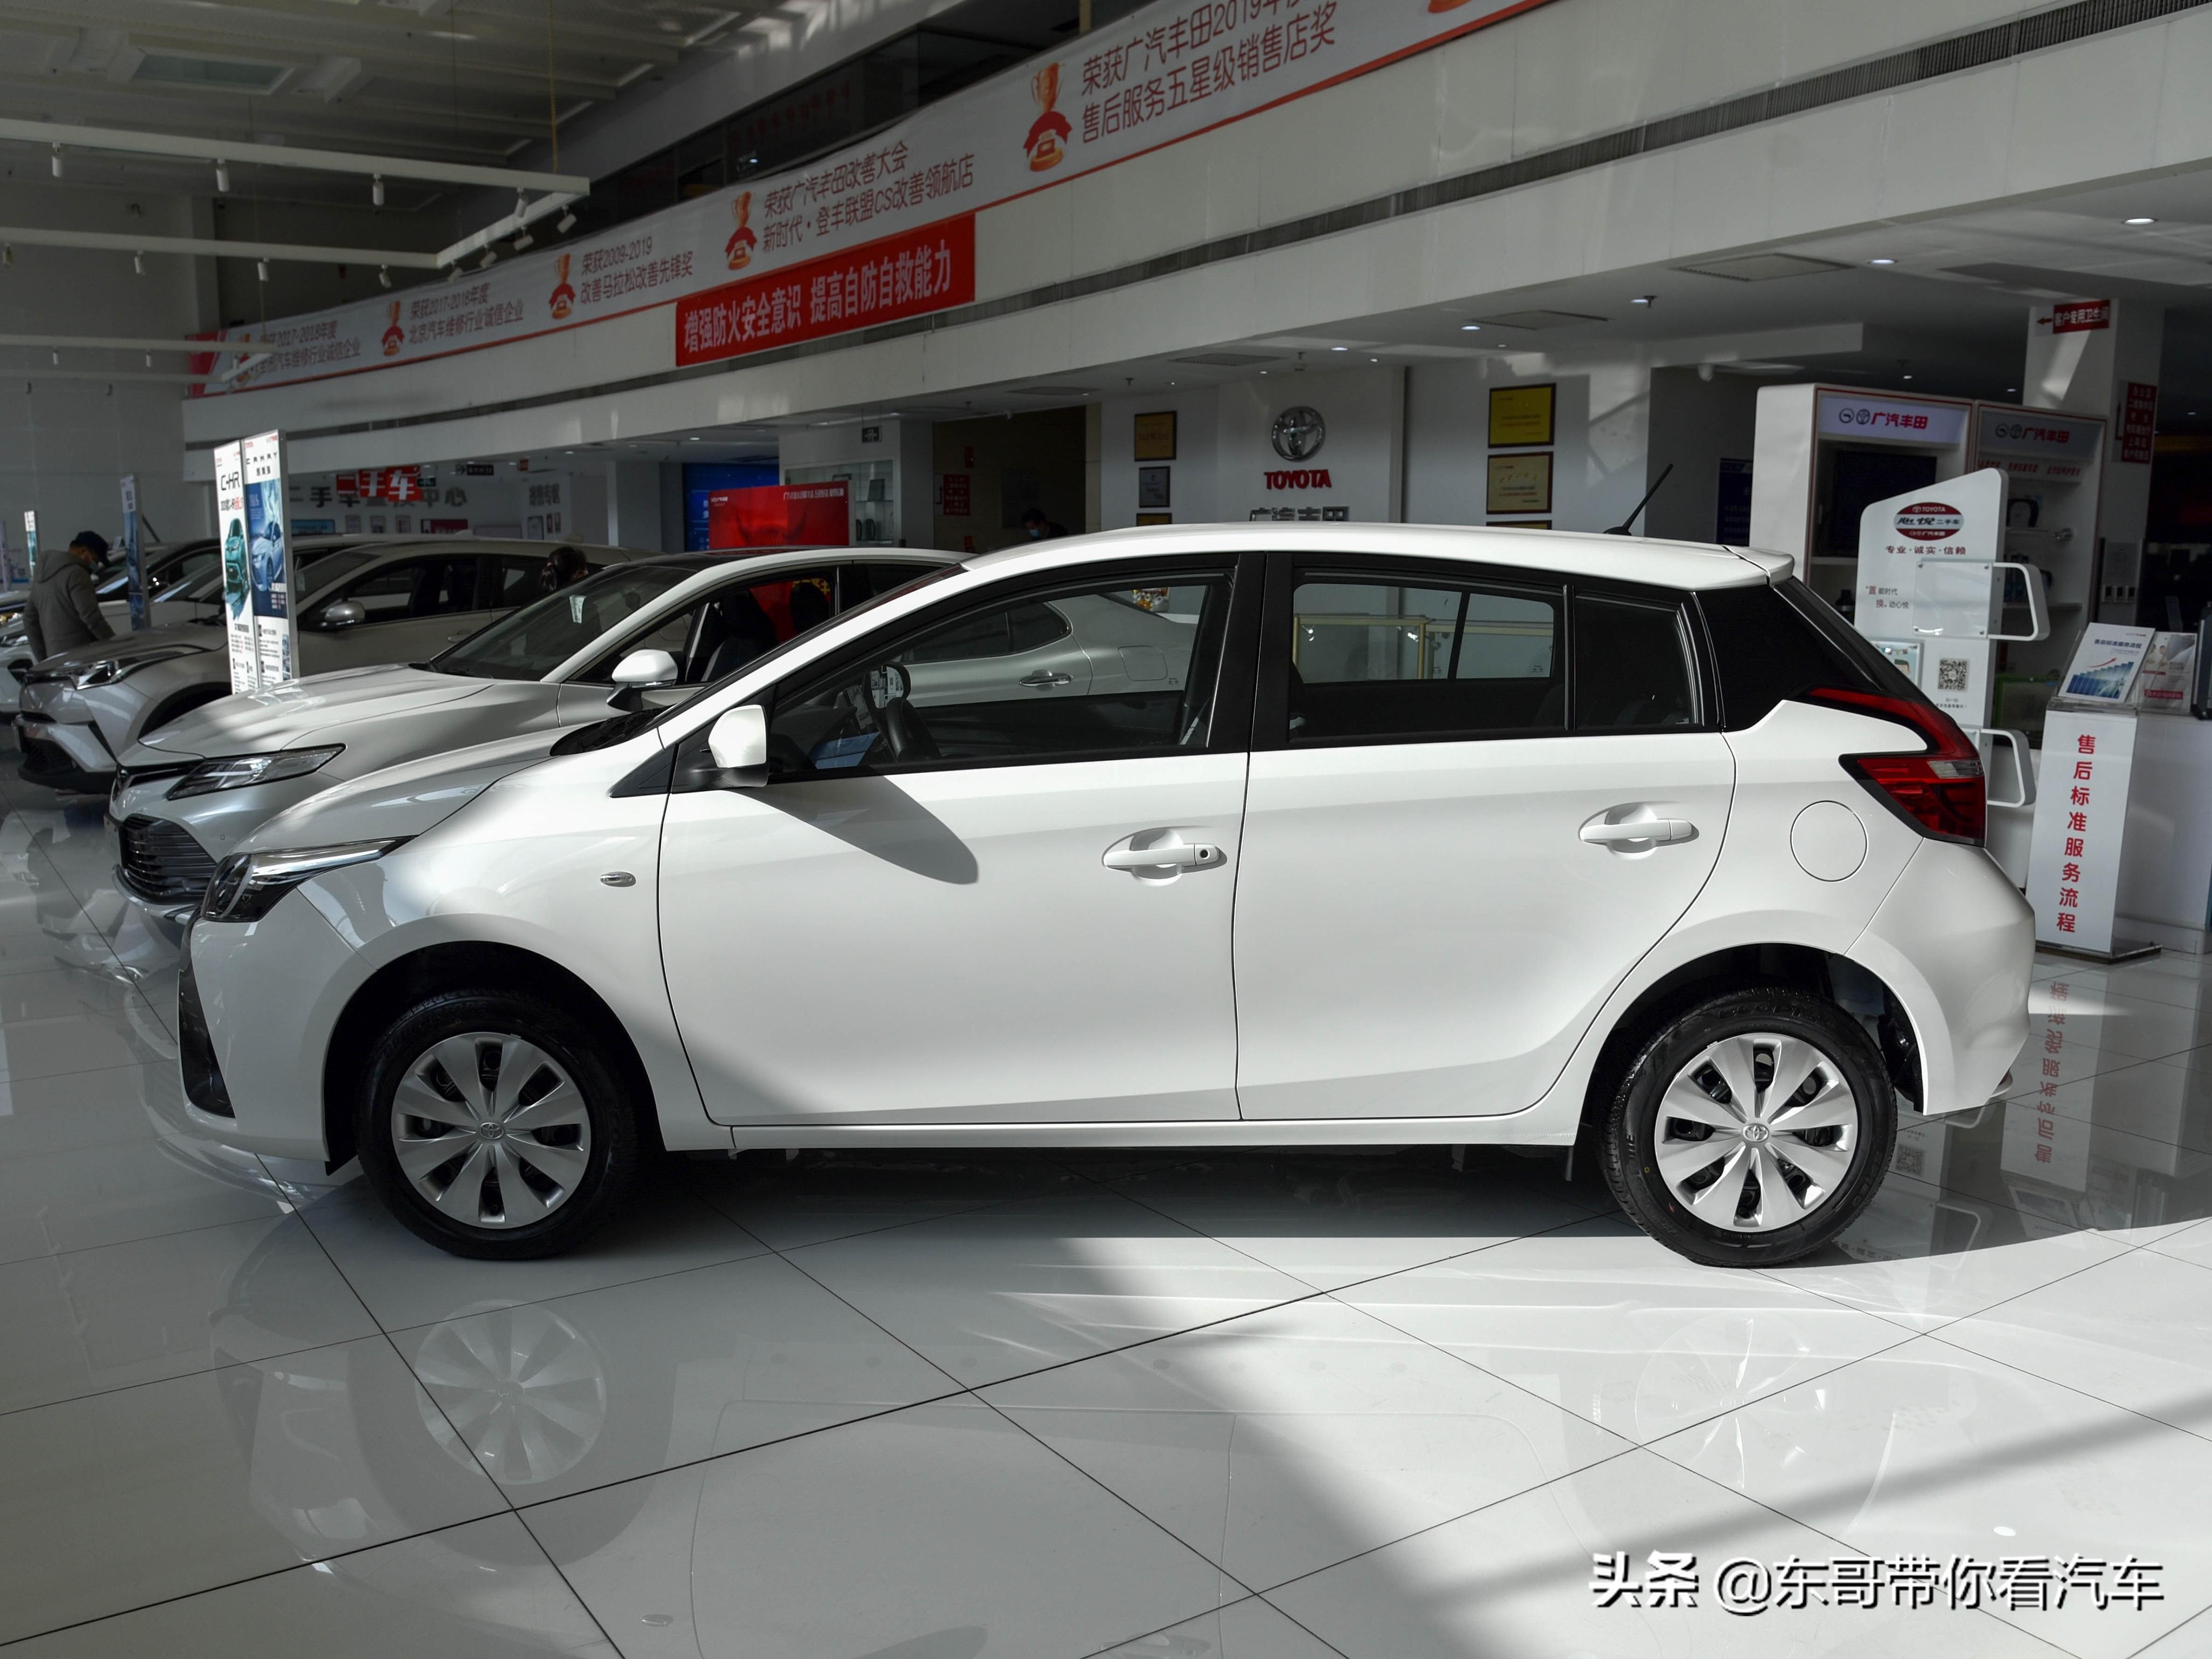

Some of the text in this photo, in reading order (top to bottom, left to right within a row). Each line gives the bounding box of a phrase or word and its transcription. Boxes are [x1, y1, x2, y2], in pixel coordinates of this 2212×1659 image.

[1081, 0, 1301, 96] 荣获广汽丰田2019
[1082, 2, 1337, 143] 售后服务五星级销售店奖
[764, 140, 908, 218] 荣获广汽丰田改善大会
[684, 239, 951, 353] 增强防火安全意识 提高自防自救能力
[1871, 412, 1928, 429] 广汽丰田
[2022, 426, 2070, 444] 广汽丰田
[338, 468, 420, 501] 二手车
[1263, 468, 1332, 491] TOYOTA
[2056, 734, 2096, 934] 售后标准服务流程
